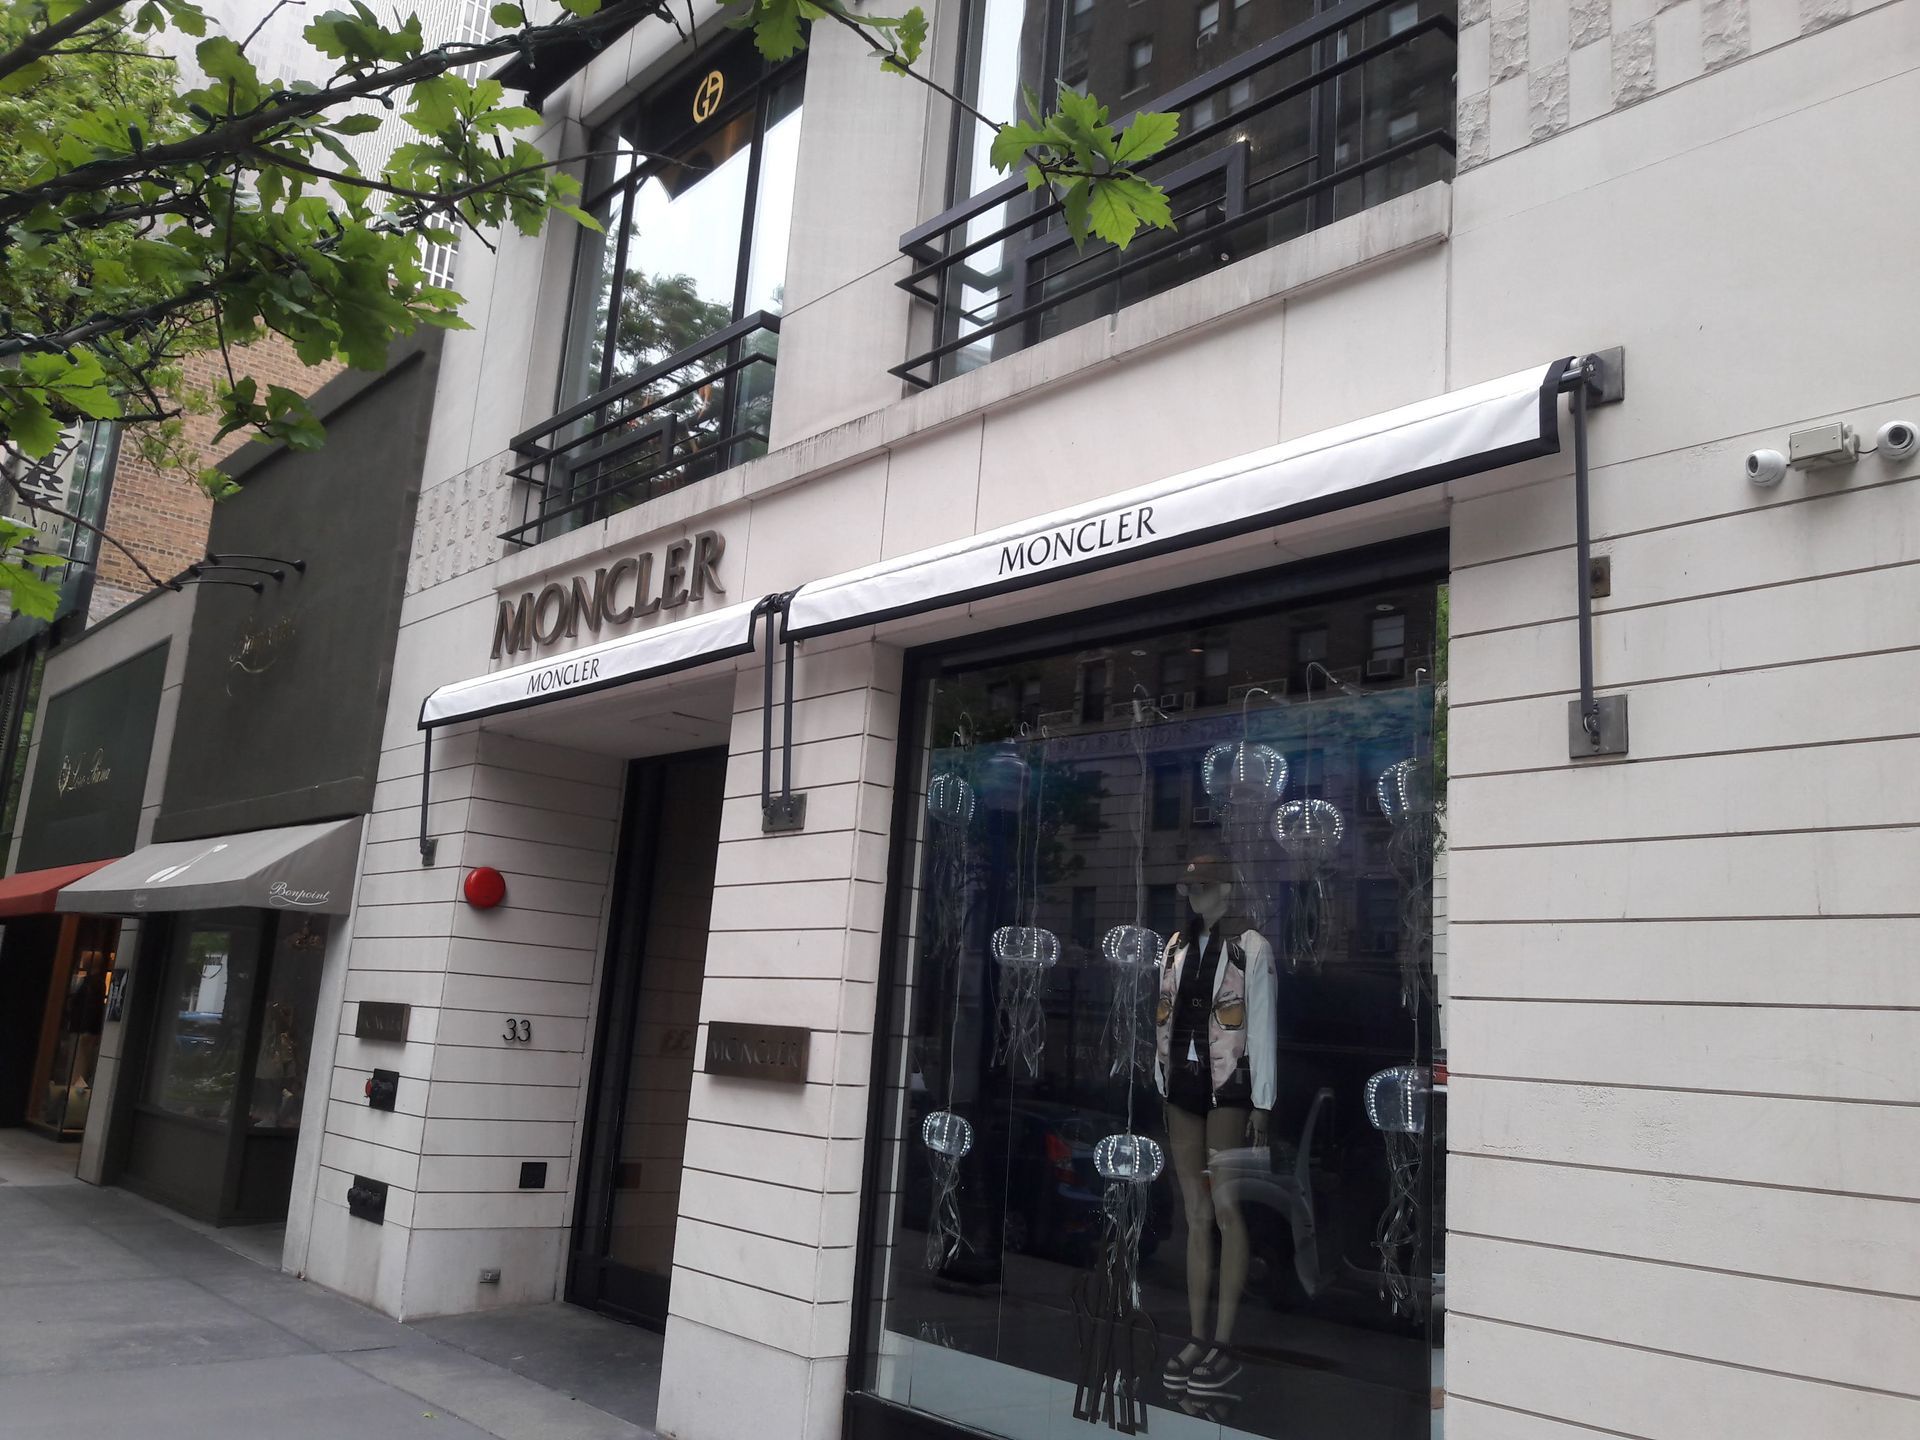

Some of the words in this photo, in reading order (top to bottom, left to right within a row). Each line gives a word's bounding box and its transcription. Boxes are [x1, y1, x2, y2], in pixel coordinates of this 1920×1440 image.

[998, 506, 1156, 575] MONCLER
[490, 529, 726, 659] MONCLER
[526, 658, 600, 695] MONCLER
[269, 881, 330, 905] Bonpoint
[503, 1018, 531, 1042] 33
